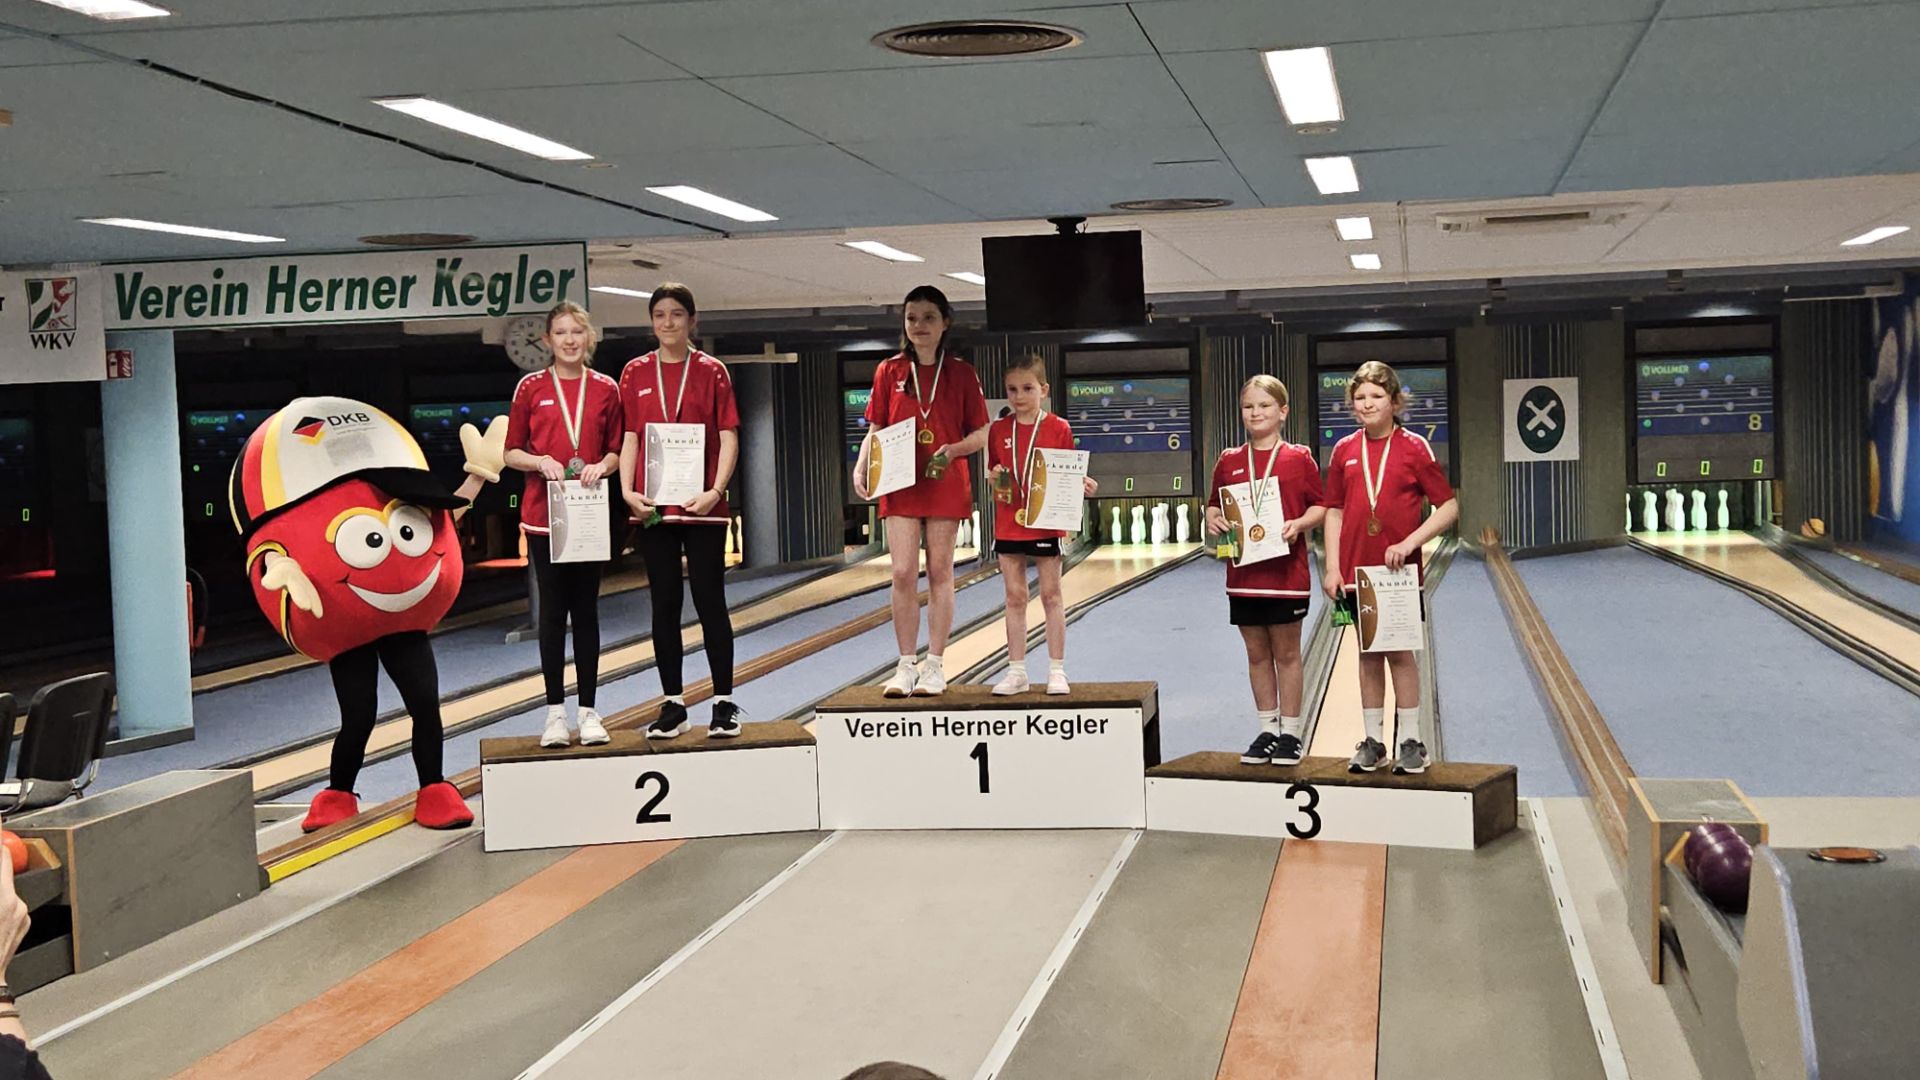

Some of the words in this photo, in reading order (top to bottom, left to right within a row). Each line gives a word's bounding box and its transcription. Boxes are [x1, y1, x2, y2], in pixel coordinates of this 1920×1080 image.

[115, 268, 248, 320] Verein
[265, 265, 417, 313] Herner
[432, 254, 575, 316] Kegler
[30, 332, 76, 350] WKV
[1080, 386, 1115, 395] VOLLMER
[327, 413, 370, 426] DKB
[1748, 413, 1762, 430] 8
[1425, 425, 1437, 440] 7
[1168, 434, 1180, 450] 6
[1657, 462, 1666, 476] 0
[1700, 461, 1710, 475] 0
[1753, 459, 1763, 473] 0
[1125, 478, 1134, 491] 0
[1173, 476, 1181, 490] 0
[1361, 580, 1413, 588] Urkunde
[845, 718, 922, 737] Verein
[932, 716, 1017, 736] Herner
[1026, 715, 1108, 740] Kegler
[969, 742, 990, 793] 1
[635, 771, 671, 824] 2
[1285, 784, 1321, 840] 3
